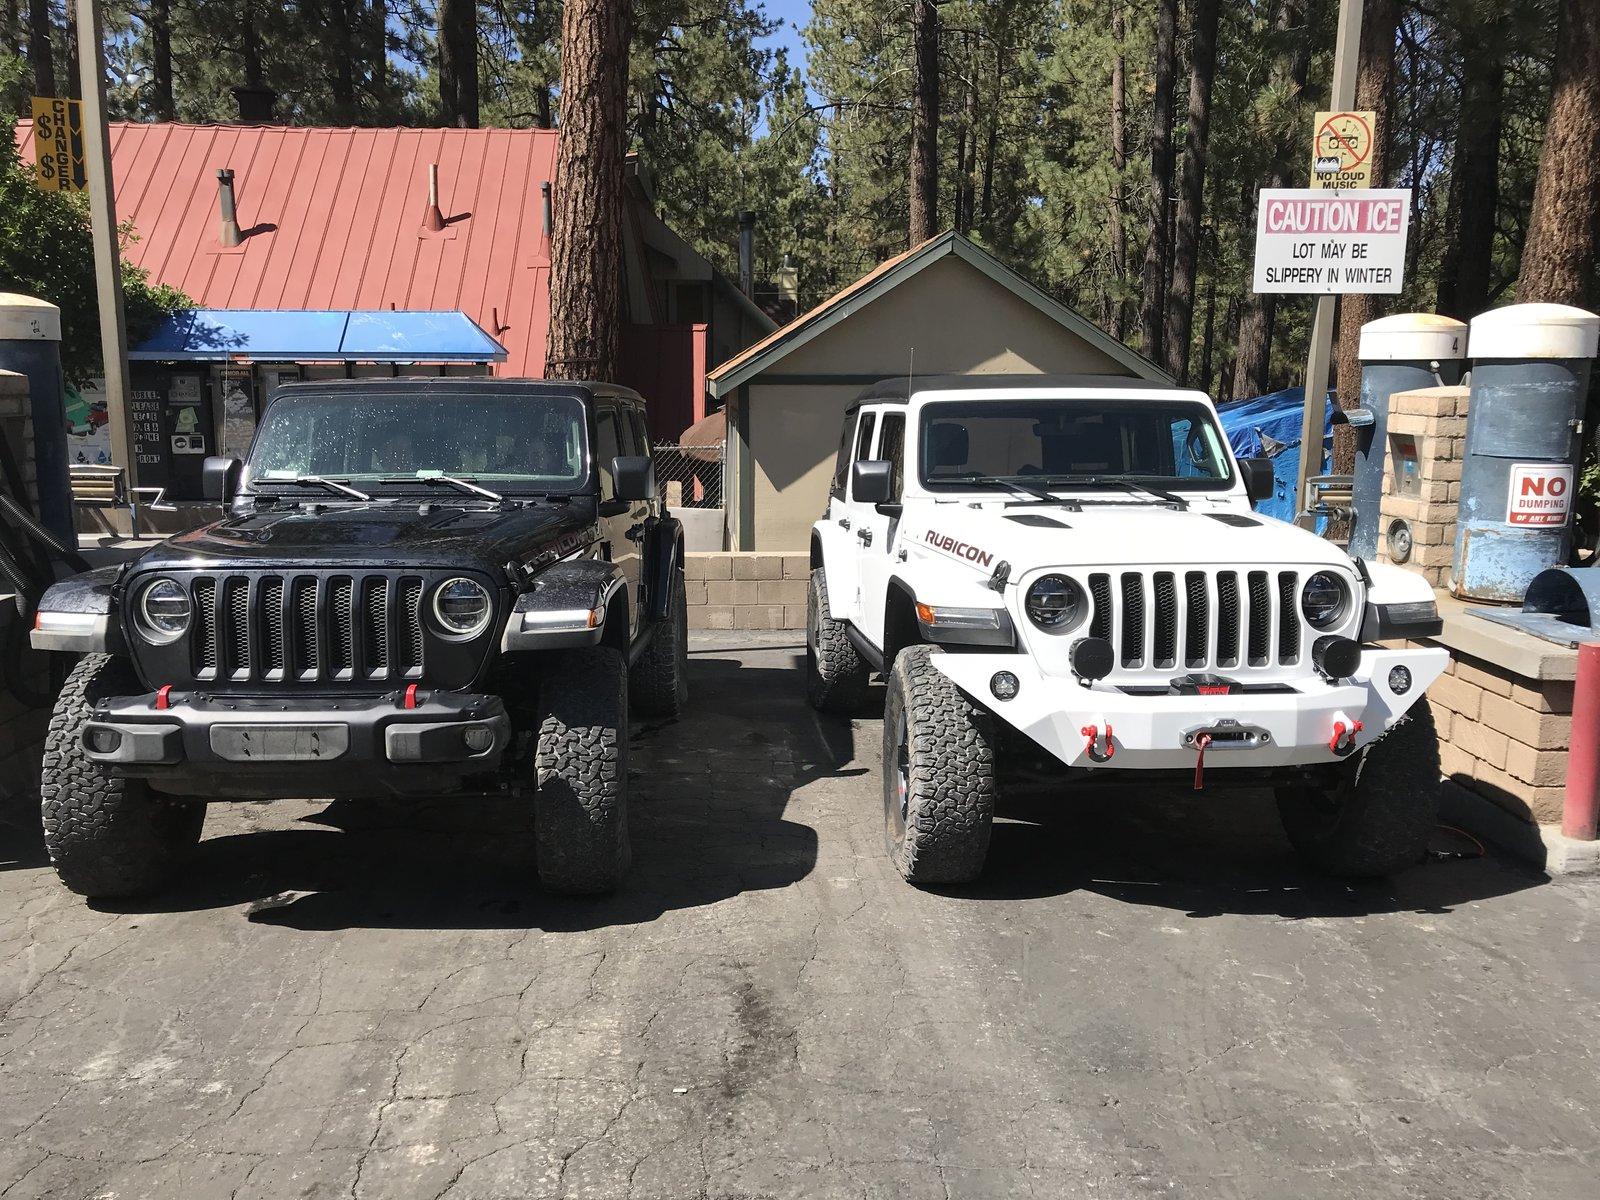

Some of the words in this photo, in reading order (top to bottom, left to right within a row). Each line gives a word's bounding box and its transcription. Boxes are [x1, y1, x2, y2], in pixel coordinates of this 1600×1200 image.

[52, 100, 71, 191] CHANGER
[1316, 172, 1332, 181] NO
[1335, 172, 1365, 181] LOUD
[1322, 181, 1358, 189] MUSIC
[1268, 201, 1360, 232] CAUTION
[1366, 202, 1401, 232] ICE
[1292, 243, 1316, 259] LOT
[1320, 243, 1347, 259] MAY
[1351, 243, 1368, 259] BE
[1265, 267, 1323, 284] SLIPPERY
[1327, 268, 1339, 283] IN
[1344, 268, 1393, 284] WINTER
[1451, 337, 1459, 353] 4
[1521, 476, 1567, 497] NO
[1519, 499, 1564, 508] DUMPING
[925, 529, 995, 567] RUBICON
